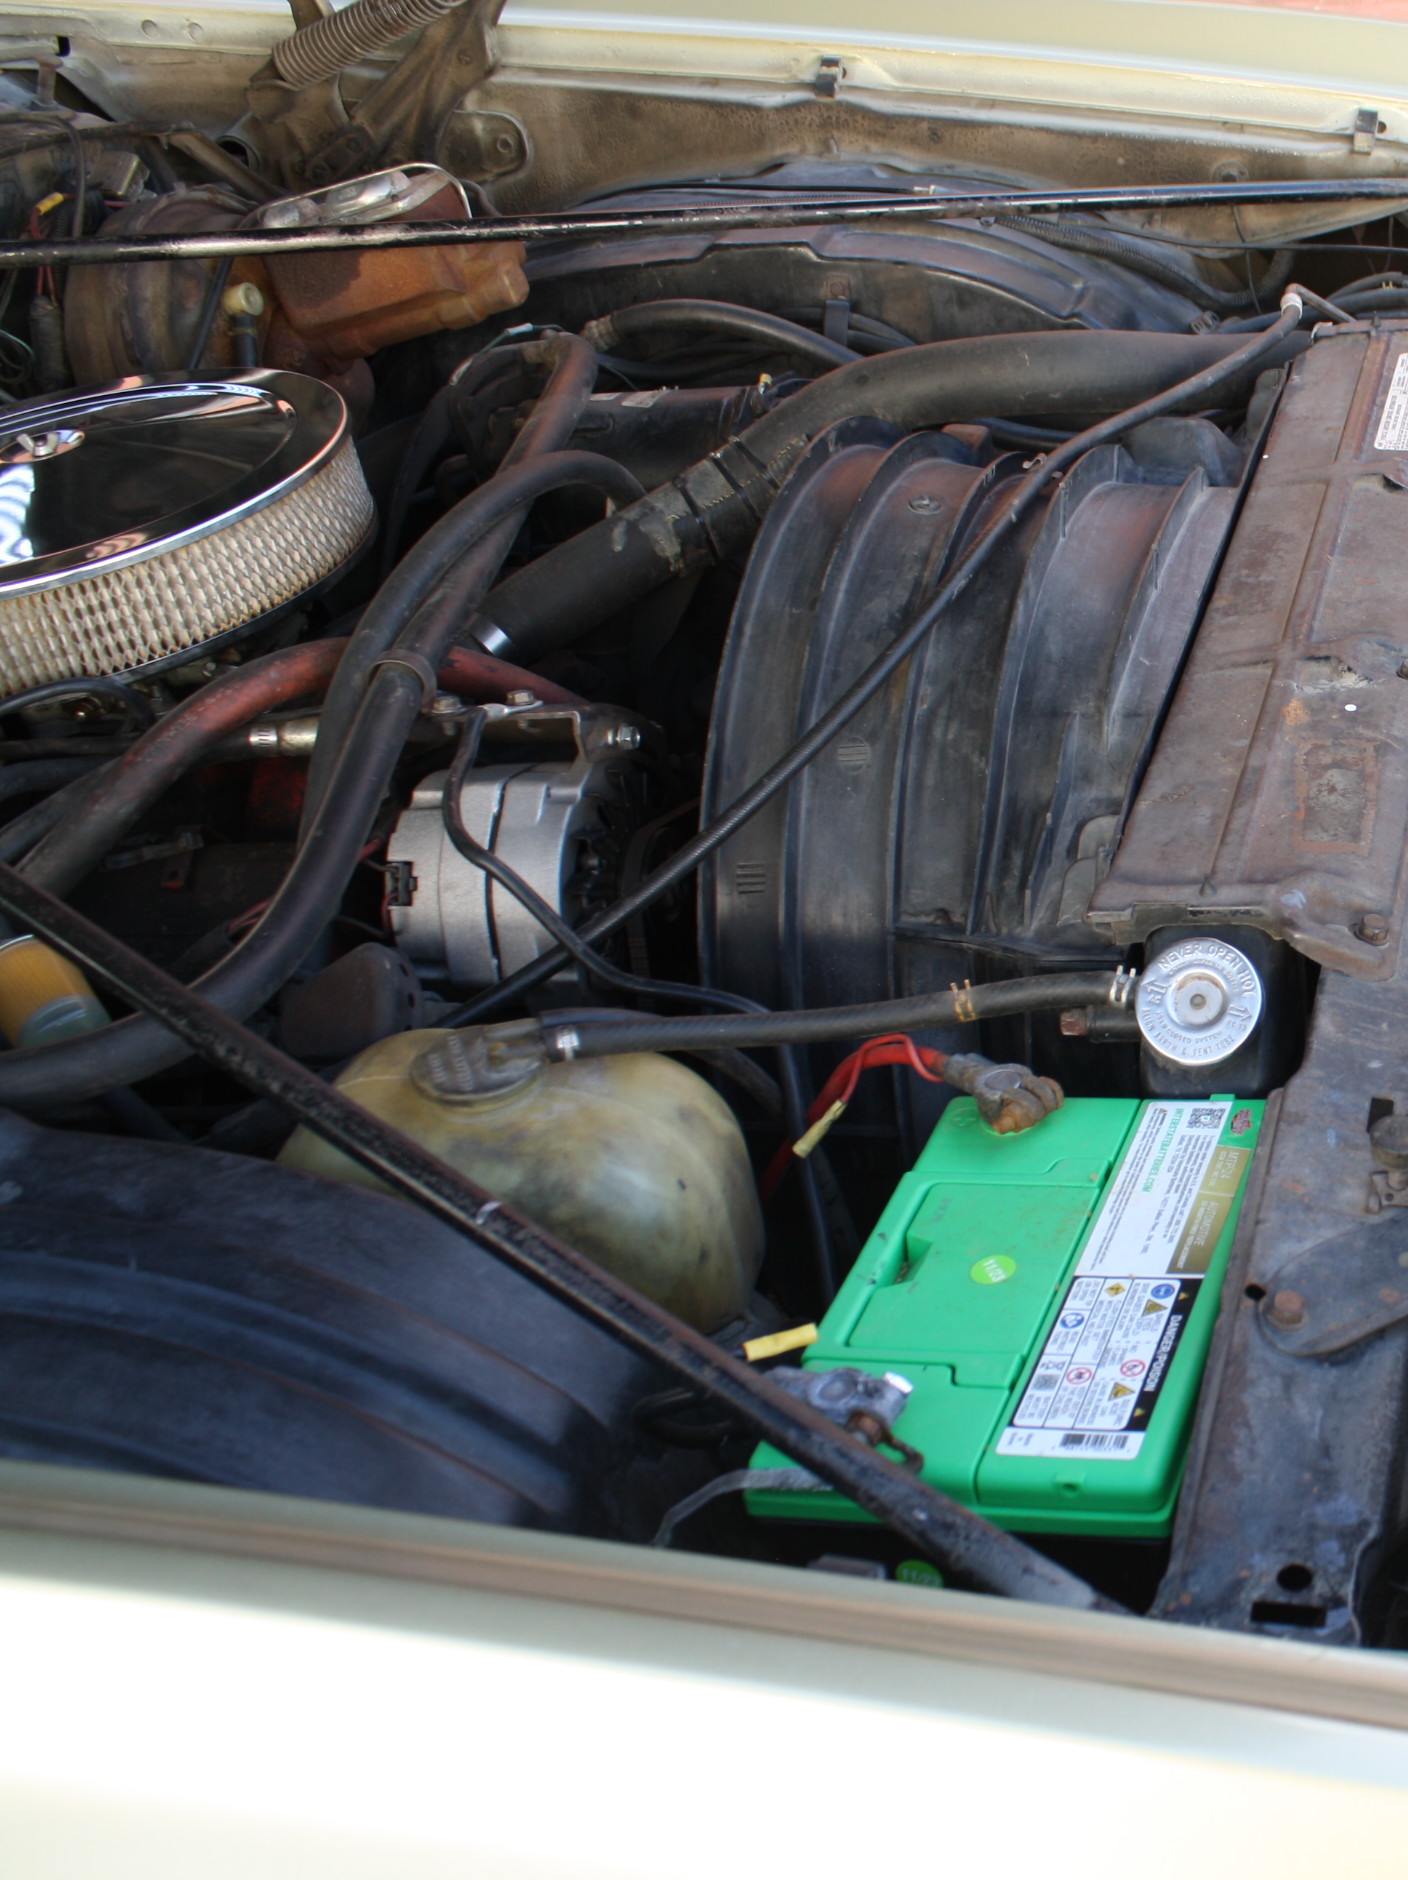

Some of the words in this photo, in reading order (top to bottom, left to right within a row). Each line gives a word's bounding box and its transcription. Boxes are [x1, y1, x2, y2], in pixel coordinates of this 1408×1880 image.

[1157, 943, 1202, 971] NEVER
[1207, 944, 1243, 970] OPEN
[1192, 1201, 1220, 1245] AUTOMOTIVE
[1142, 1314, 1183, 1391] DANGER/POISON
